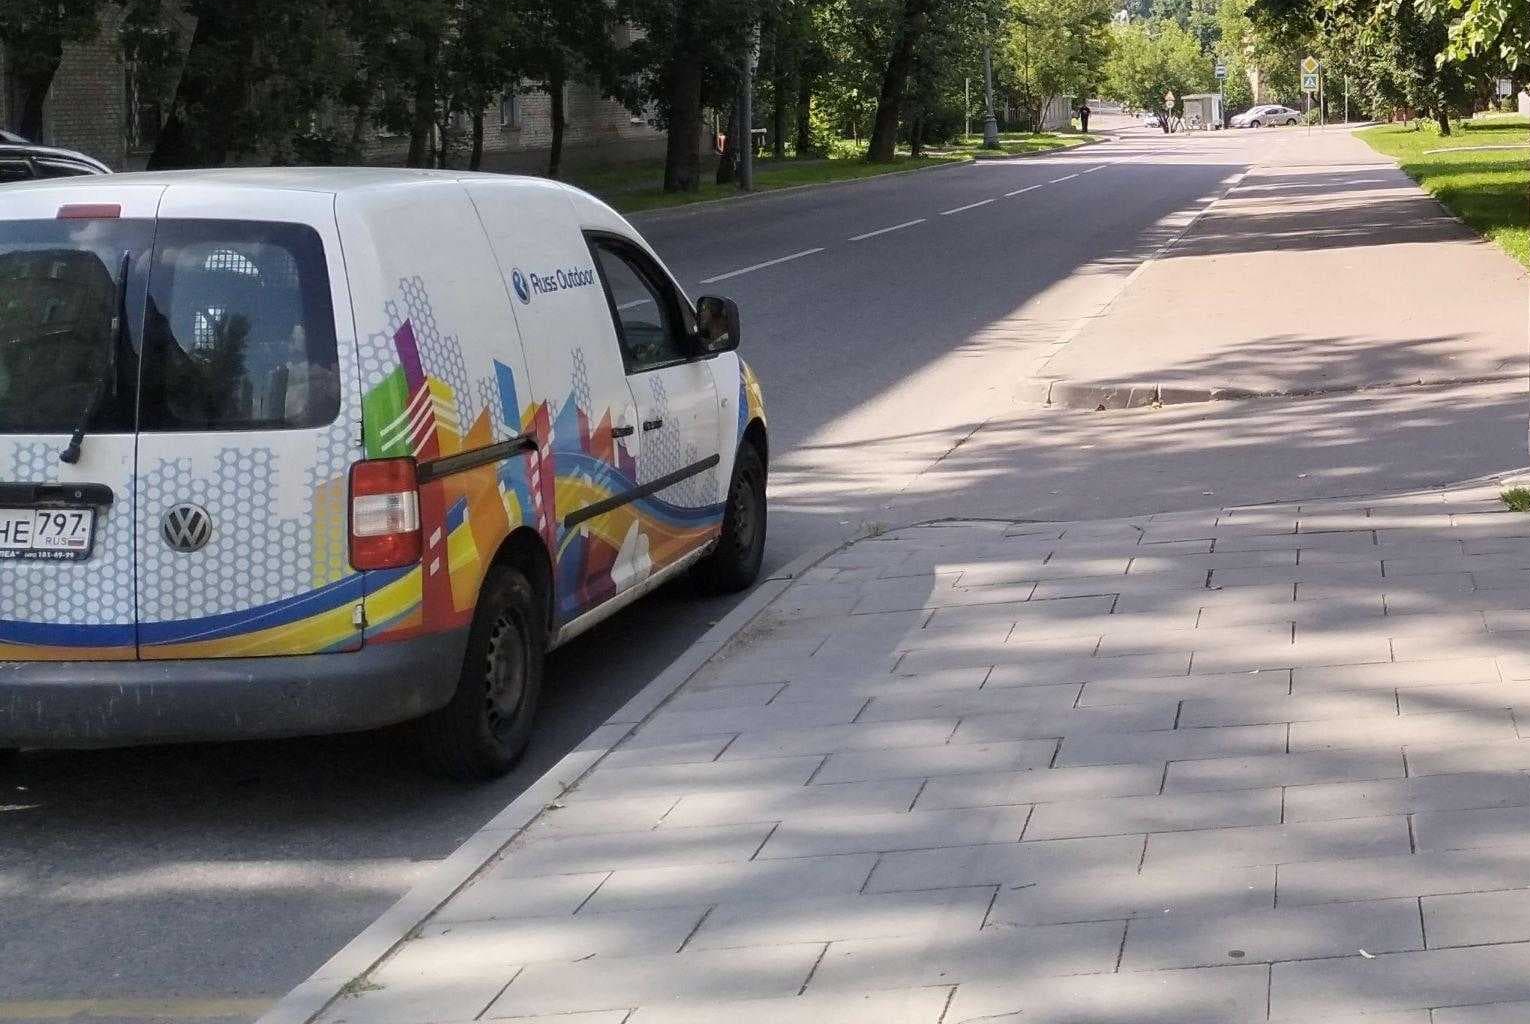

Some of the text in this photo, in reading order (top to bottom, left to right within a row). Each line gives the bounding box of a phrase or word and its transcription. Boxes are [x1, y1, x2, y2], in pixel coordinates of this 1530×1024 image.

[529, 266, 596, 295] Russ Outdoor
[38, 512, 83, 536] 797
[45, 536, 68, 546] RUS
